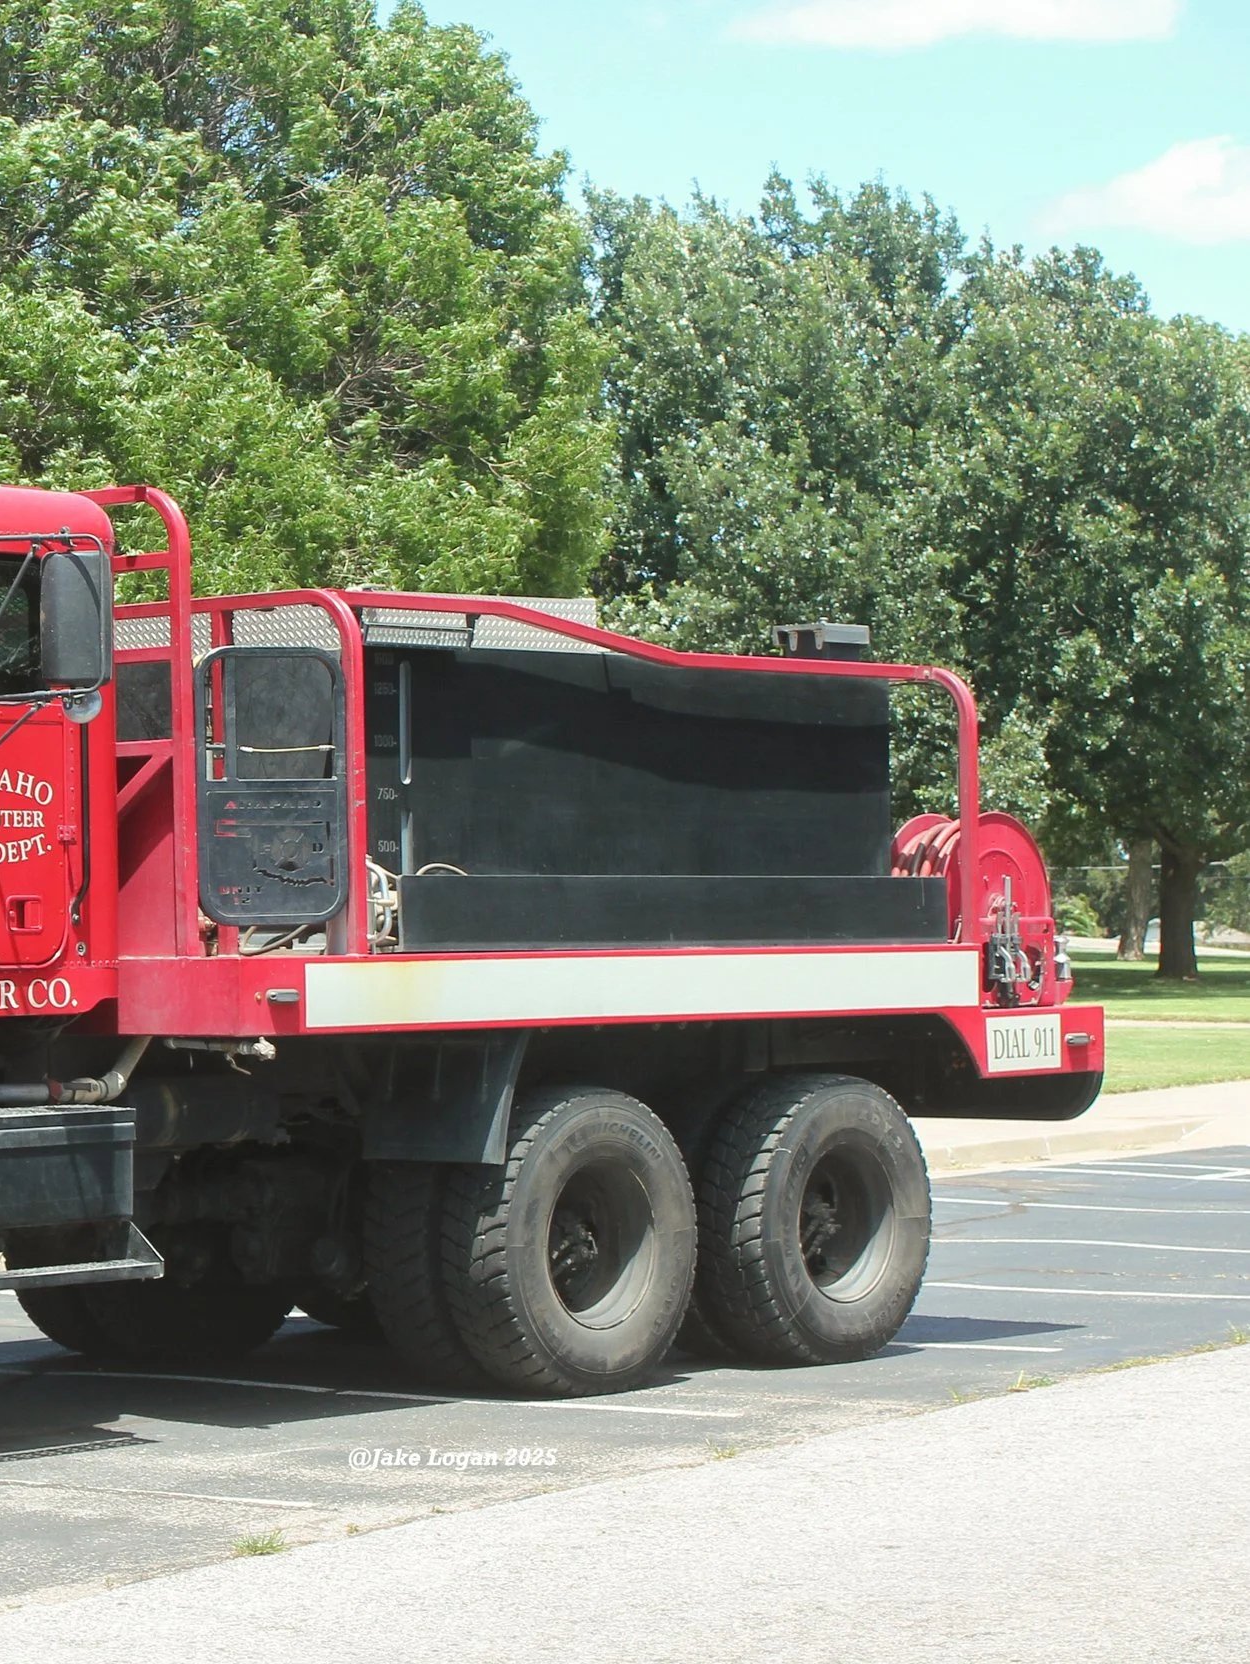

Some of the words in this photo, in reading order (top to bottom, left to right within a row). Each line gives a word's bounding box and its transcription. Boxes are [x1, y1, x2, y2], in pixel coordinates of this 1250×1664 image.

[27, 977, 79, 1009] CO.
[992, 1028, 1031, 1060] DIAL
[1034, 1027, 1056, 1058] 911
